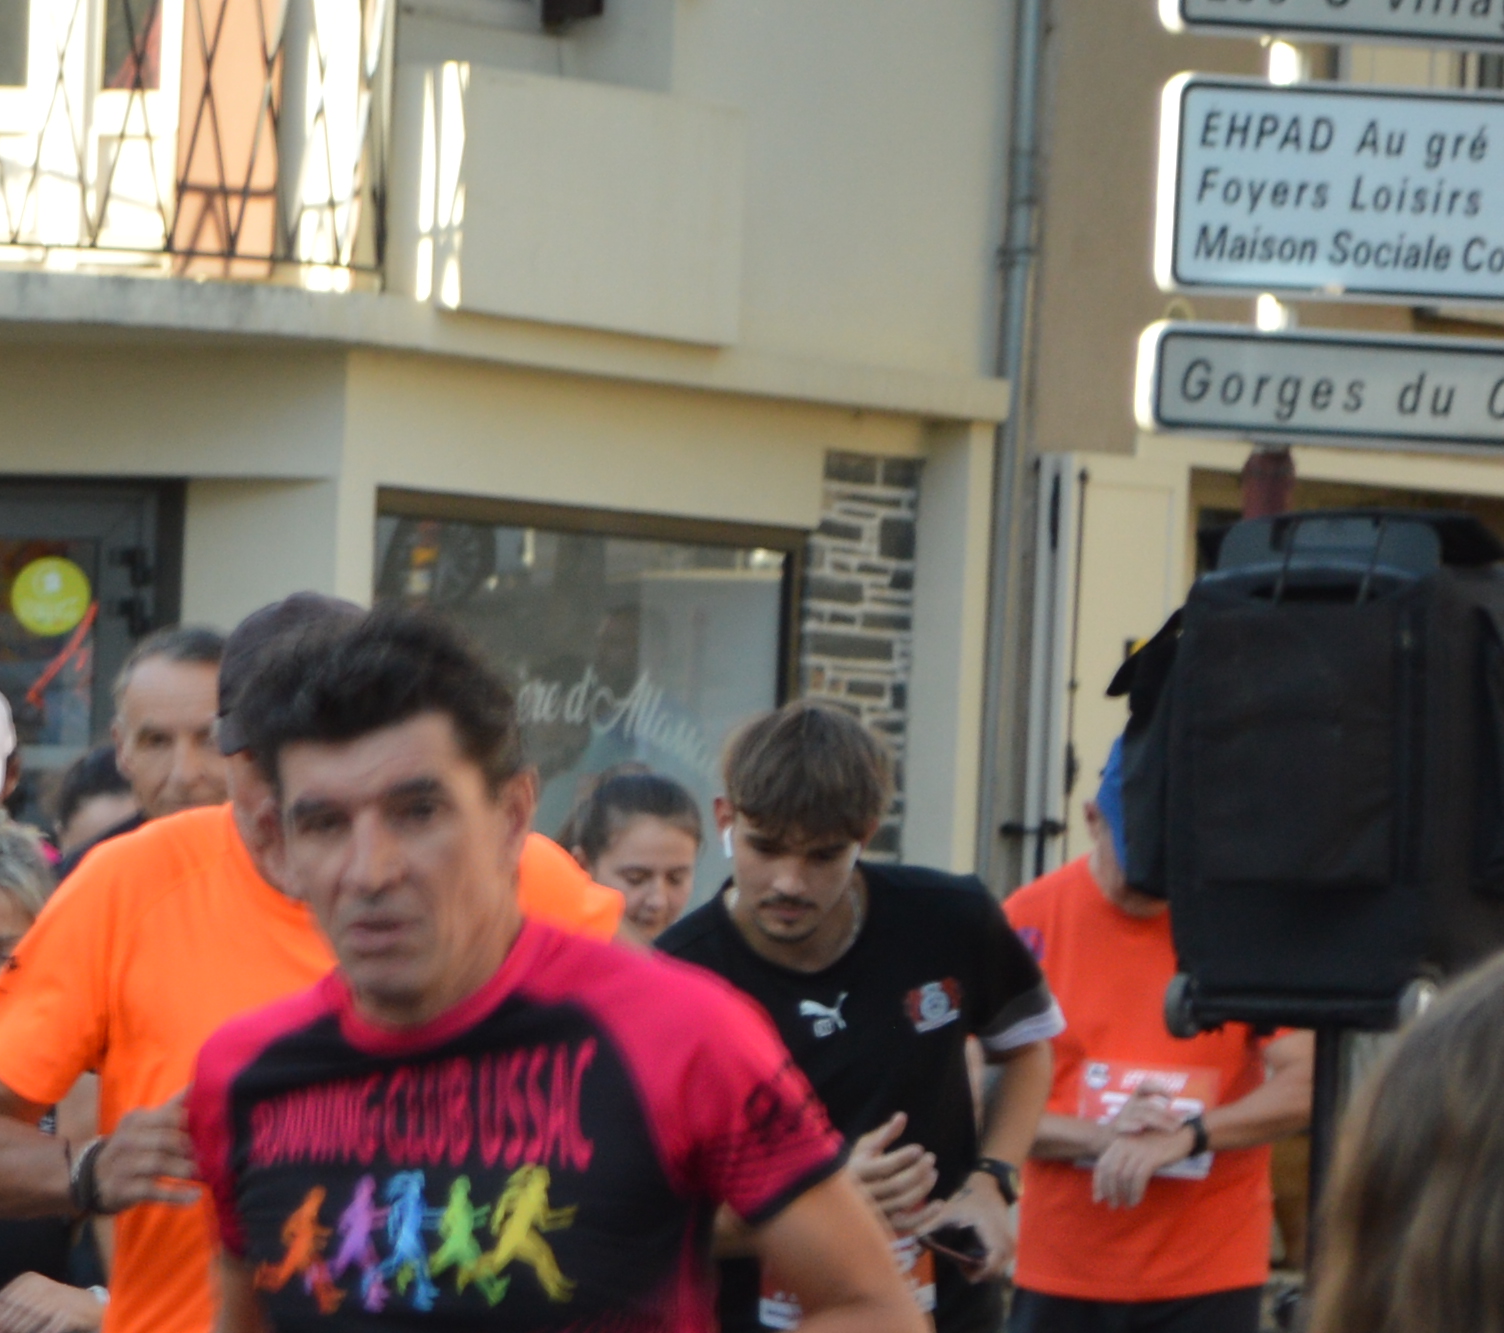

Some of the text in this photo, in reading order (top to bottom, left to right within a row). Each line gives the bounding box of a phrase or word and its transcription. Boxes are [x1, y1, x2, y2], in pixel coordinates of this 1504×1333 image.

[1200, 111, 1489, 168] EHPAD Au gré
[1197, 167, 1481, 217] Foyers Loisirs
[1194, 224, 1317, 264] Maison
[1329, 230, 1451, 272] Sociale
[1180, 358, 1366, 422] Gorges
[1397, 371, 1455, 419] du
[384, 1056, 473, 1167] CLUB
[479, 1036, 598, 1173] USSAC
